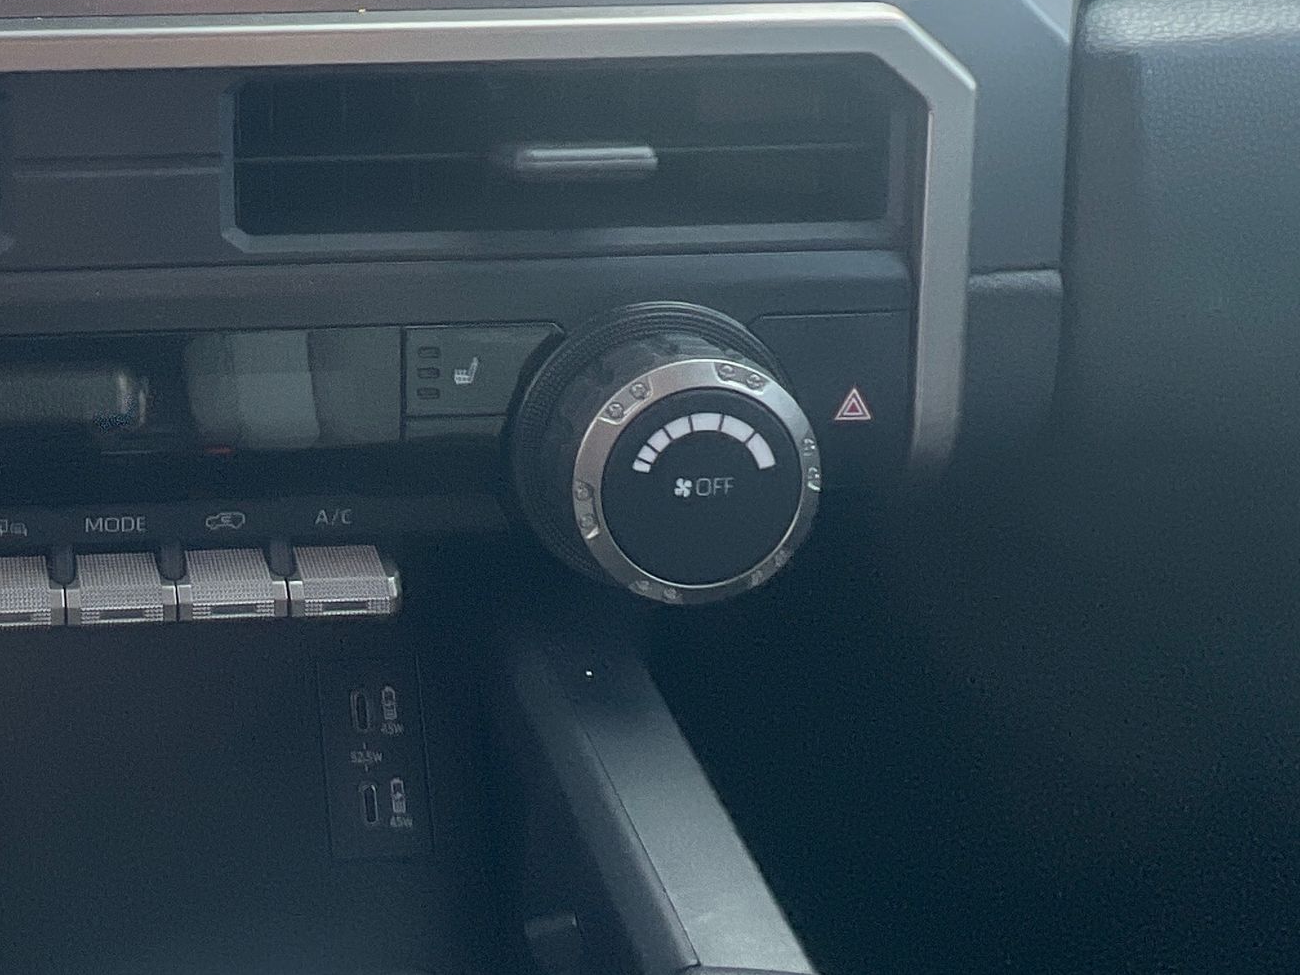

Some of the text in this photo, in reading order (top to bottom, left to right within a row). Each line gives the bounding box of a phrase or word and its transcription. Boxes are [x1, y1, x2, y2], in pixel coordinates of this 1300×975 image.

[695, 478, 735, 496] OFF
[85, 515, 146, 533] MODE
[315, 508, 352, 526] A/C
